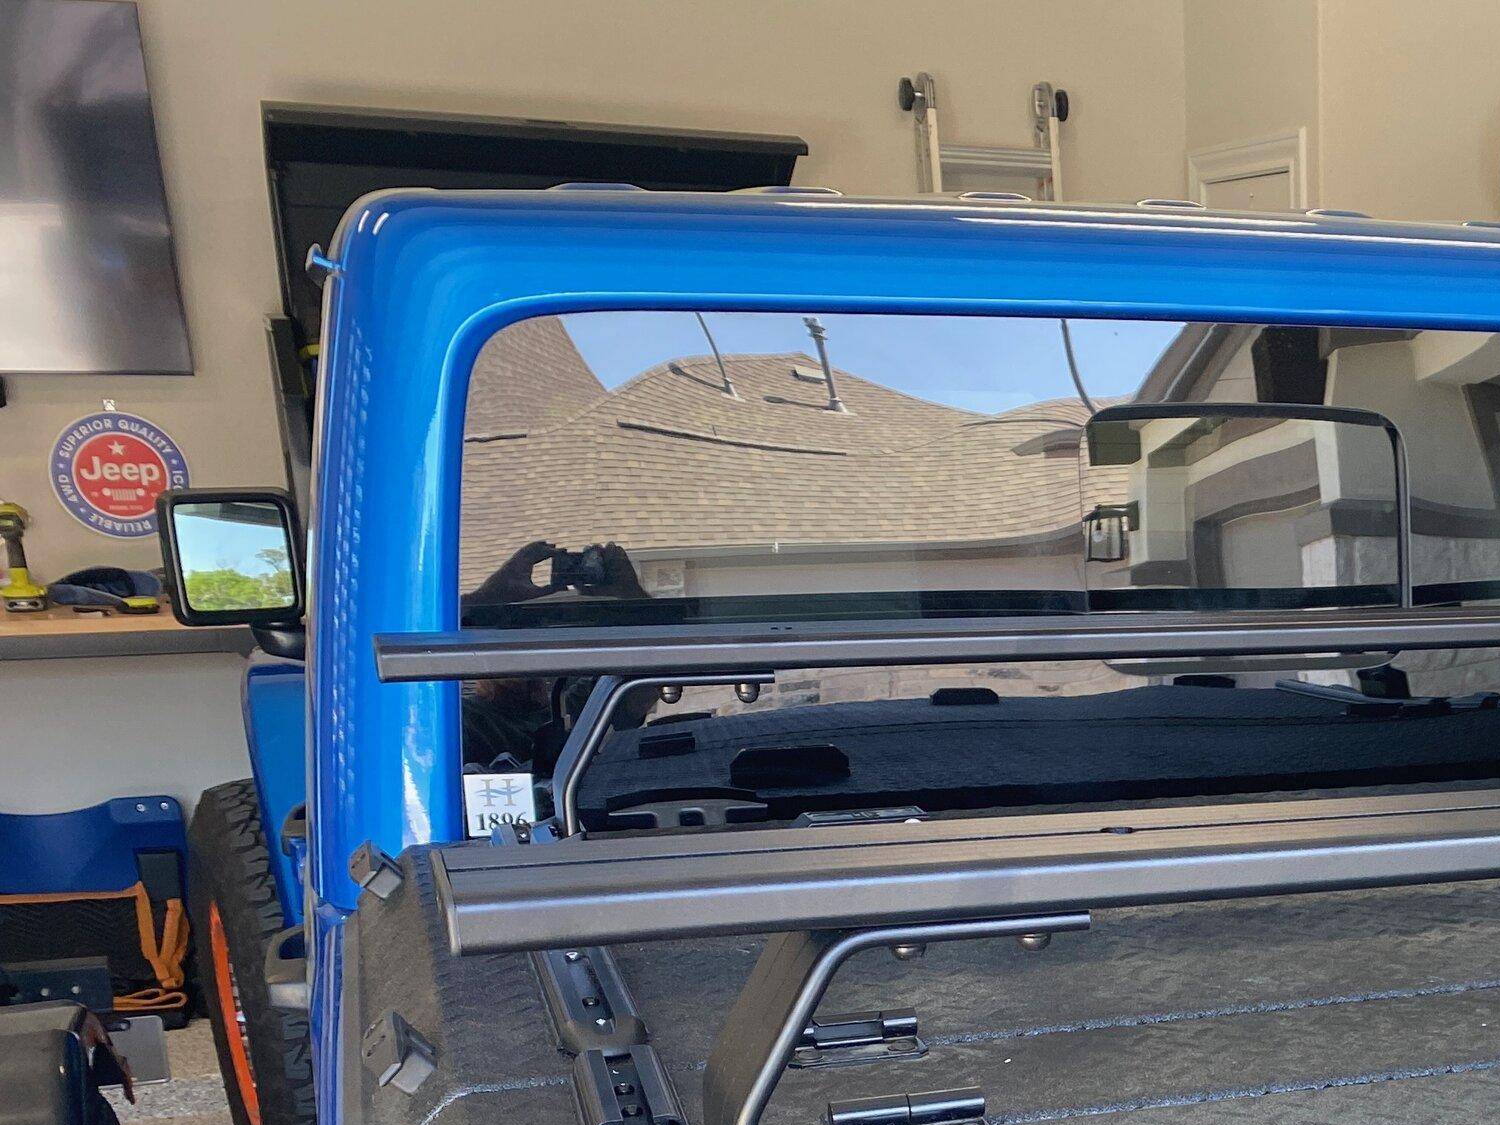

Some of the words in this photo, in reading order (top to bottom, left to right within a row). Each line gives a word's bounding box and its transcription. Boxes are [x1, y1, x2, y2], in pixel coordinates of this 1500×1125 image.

[59, 418, 112, 458] SUPERIOR
[117, 419, 173, 453] QUALITY
[80, 456, 160, 486] Jeep
[88, 513, 152, 532] RELIABLE
